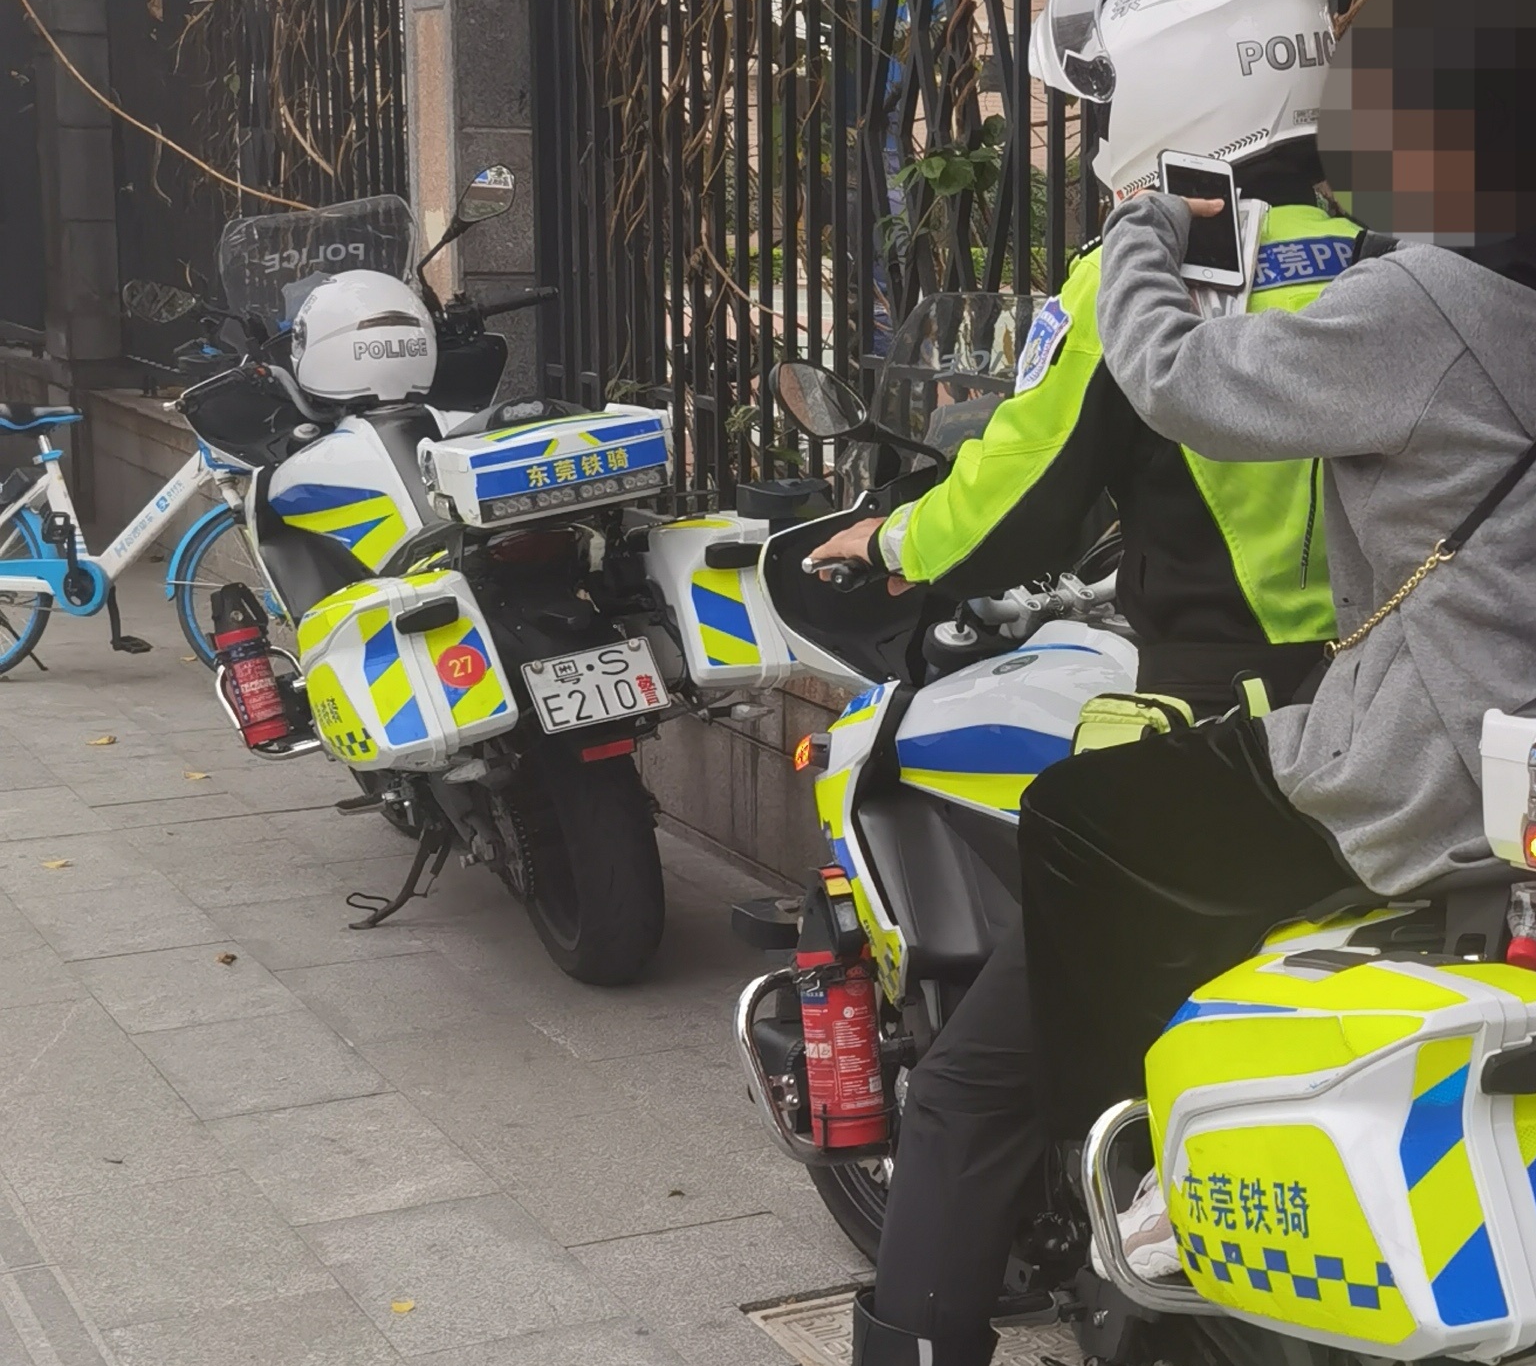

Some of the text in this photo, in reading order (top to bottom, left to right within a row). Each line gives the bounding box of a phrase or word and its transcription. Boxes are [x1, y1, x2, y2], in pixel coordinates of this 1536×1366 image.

[353, 338, 428, 361] POLICE
[526, 448, 629, 488] 东莞铁骑
[448, 655, 473, 678] 27
[1184, 1168, 1310, 1238] 东莞铁骑
